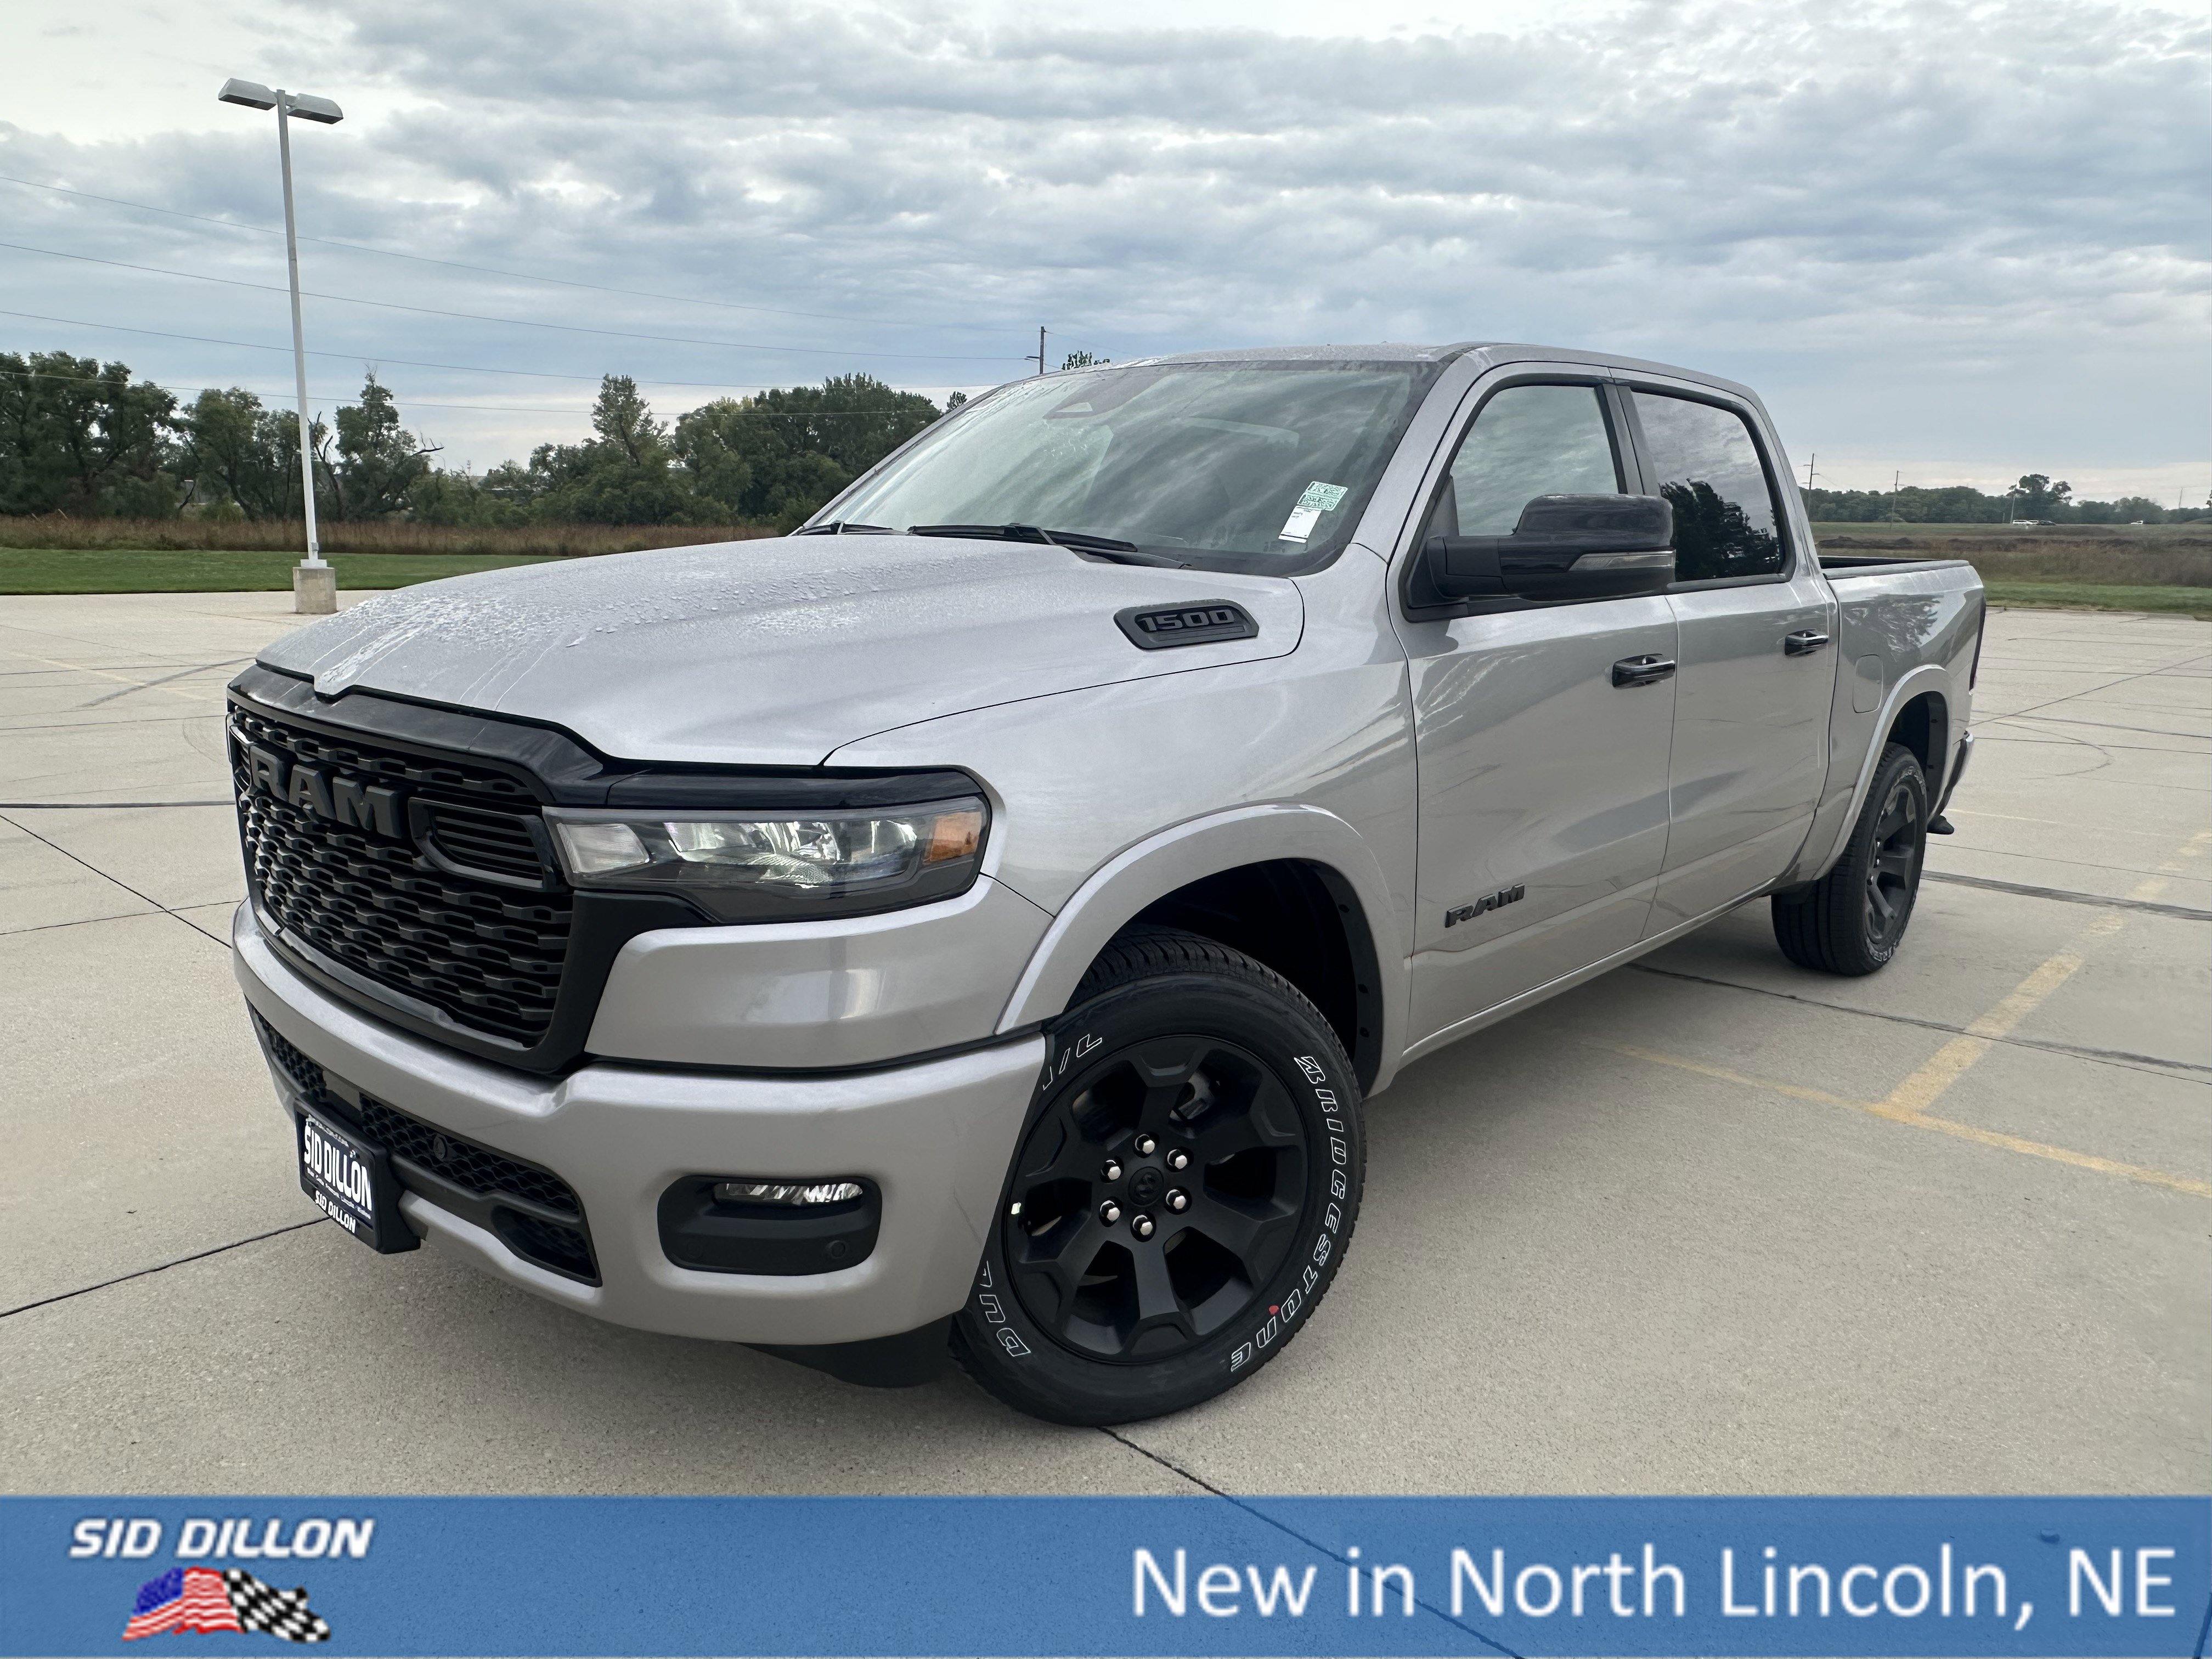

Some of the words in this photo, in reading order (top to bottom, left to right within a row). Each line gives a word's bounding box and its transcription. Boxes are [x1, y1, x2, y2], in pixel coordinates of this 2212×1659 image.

[1137, 609, 1235, 631] 1500
[250, 744, 403, 838] RAM
[1444, 883, 1525, 928] RAM
[304, 1124, 322, 1174] SID
[324, 1140, 373, 1211] DILLON
[315, 1190, 328, 1211] SID
[328, 1201, 357, 1233] DILLON
[1231, 1055, 1346, 1372] BRIDGESTONE
